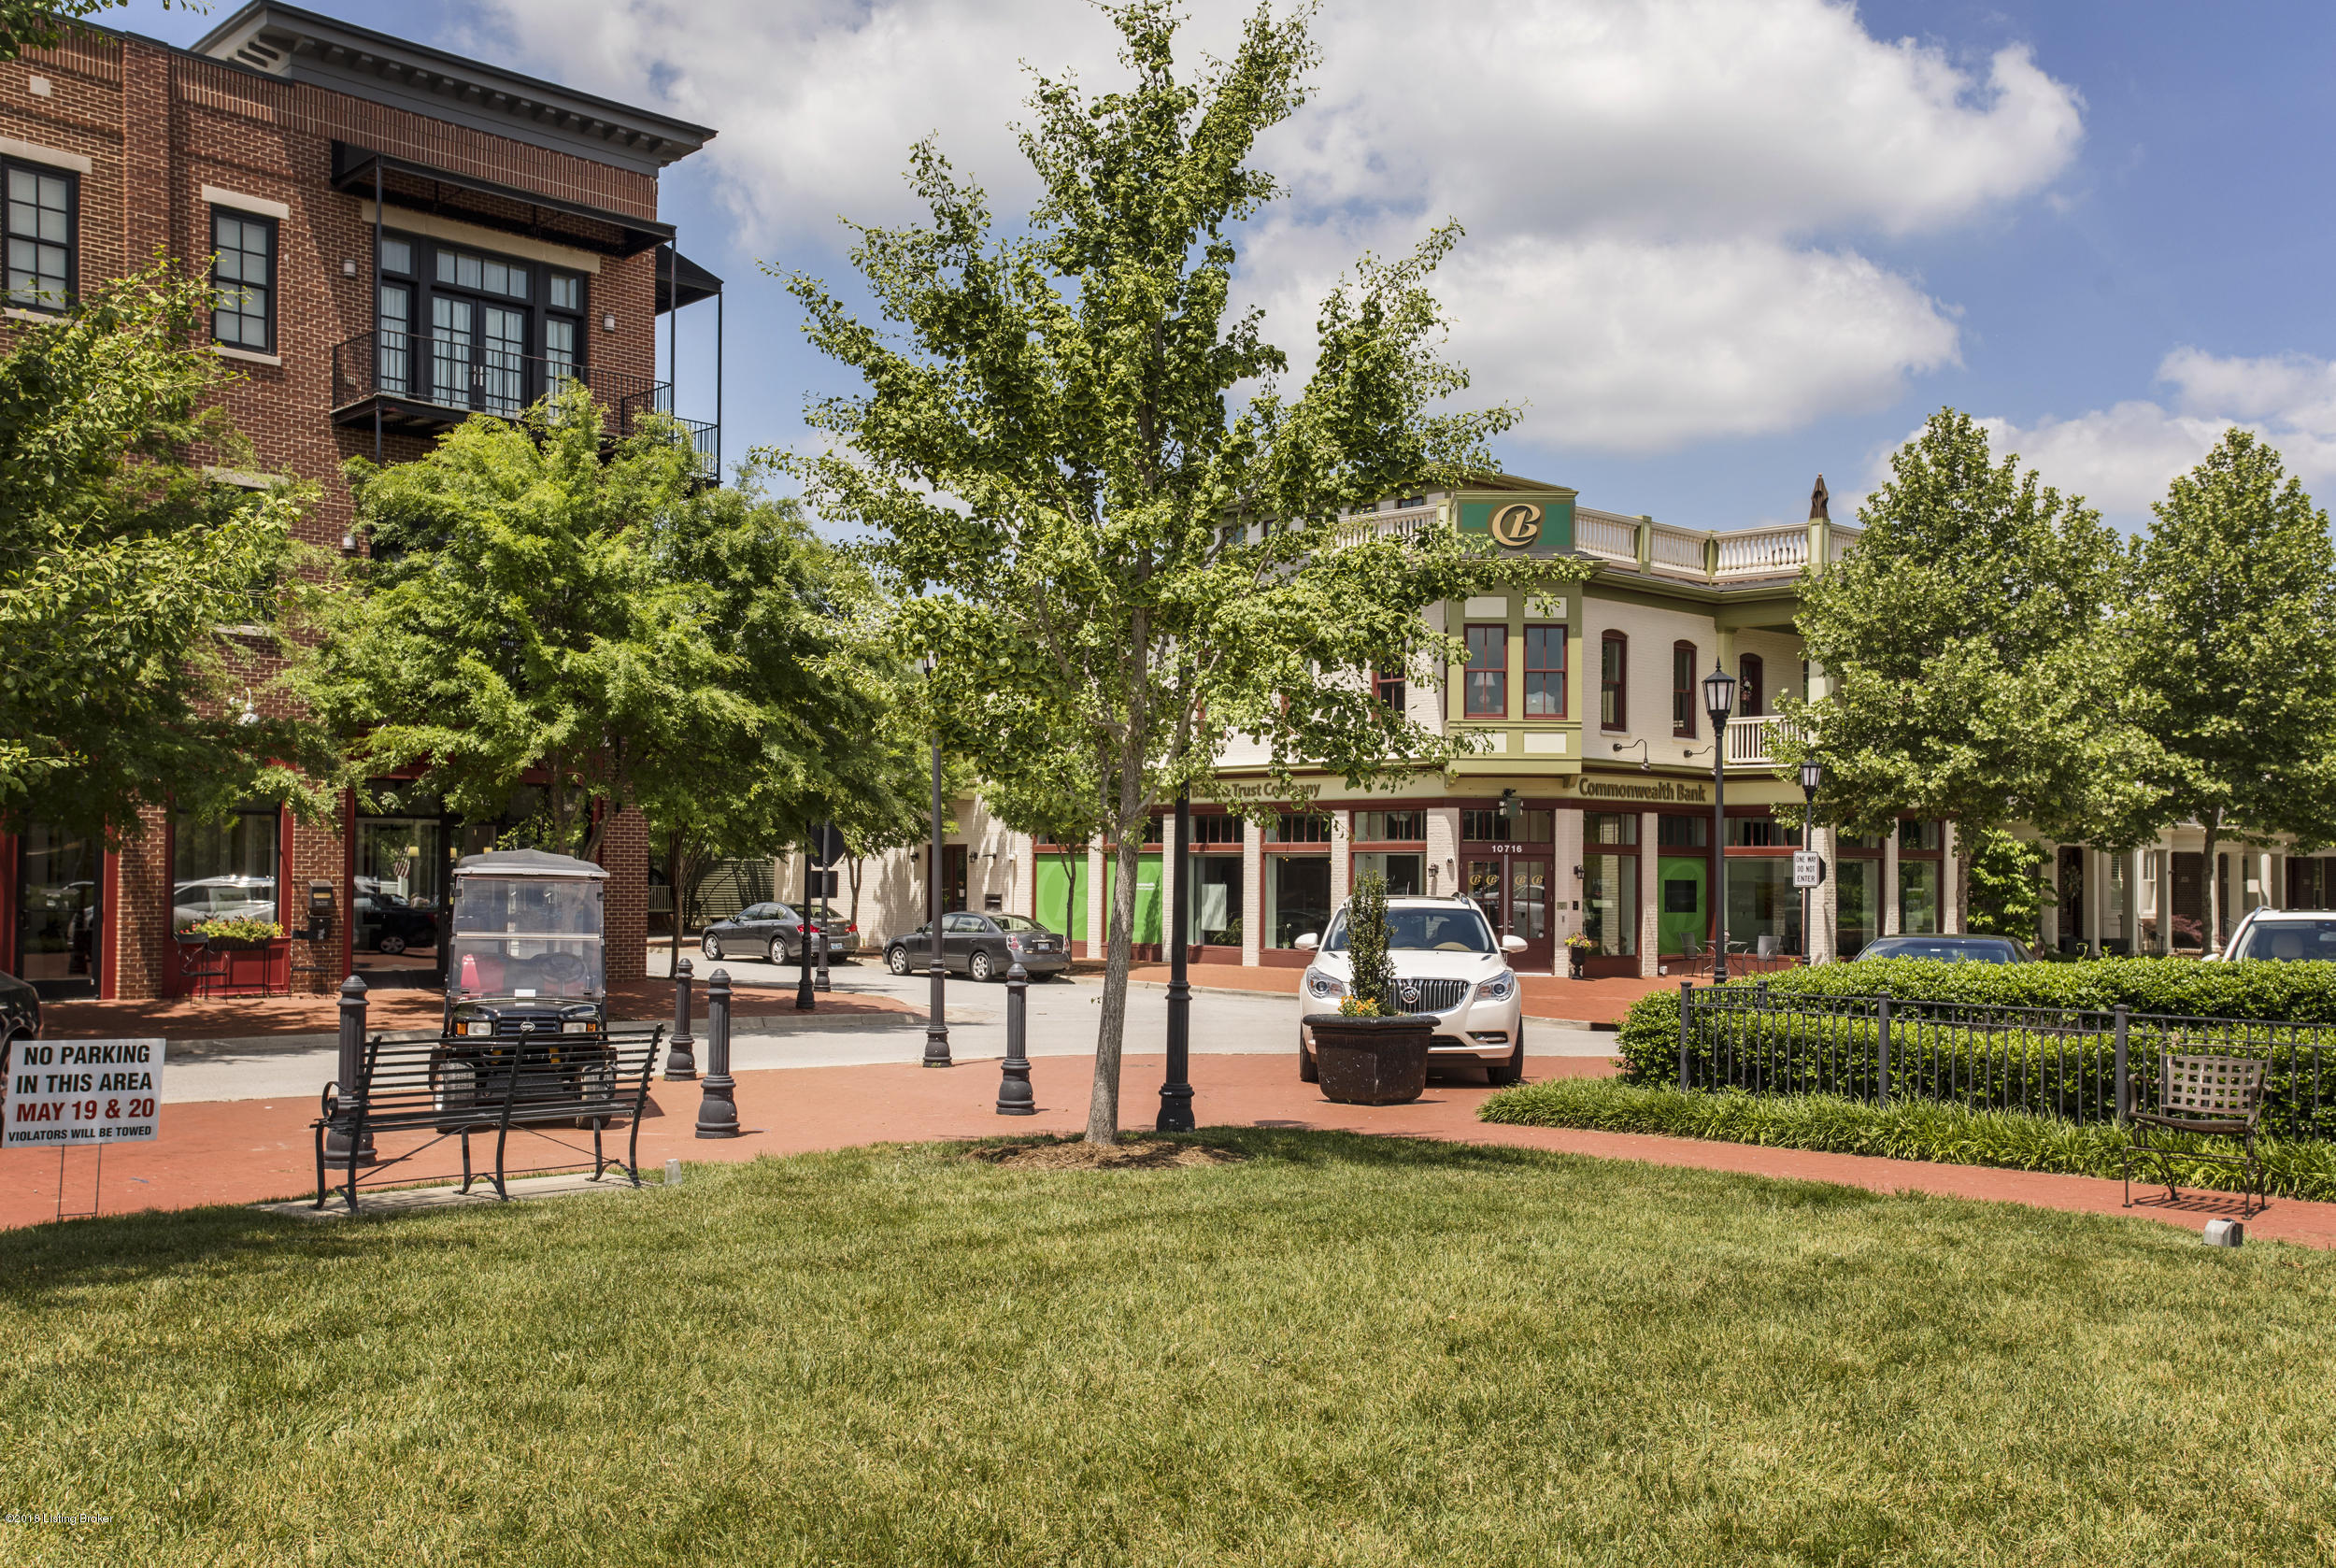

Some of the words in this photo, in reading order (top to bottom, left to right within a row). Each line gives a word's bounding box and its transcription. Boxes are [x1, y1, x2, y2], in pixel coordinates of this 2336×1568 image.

[1191, 784, 1218, 798] Ba
[1232, 783, 1261, 797] Trust
[1579, 777, 1674, 801] Commonwealth
[1677, 783, 1706, 802] Bank
[1491, 845, 1522, 853] 10716
[23, 1046, 53, 1065] NO
[60, 1045, 150, 1064] PARKING
[16, 1075, 38, 1094] IN
[46, 1074, 92, 1093] THIS
[98, 1072, 152, 1091] AREA
[16, 1103, 65, 1122] MAY
[72, 1100, 97, 1120] 19
[105, 1099, 121, 1119] &
[128, 1098, 155, 1119] 20
[8, 1129, 67, 1142] VIOLATORS
[71, 1128, 95, 1139] WILL
[99, 1127, 113, 1137] BE
[116, 1126, 151, 1137] TOWED
